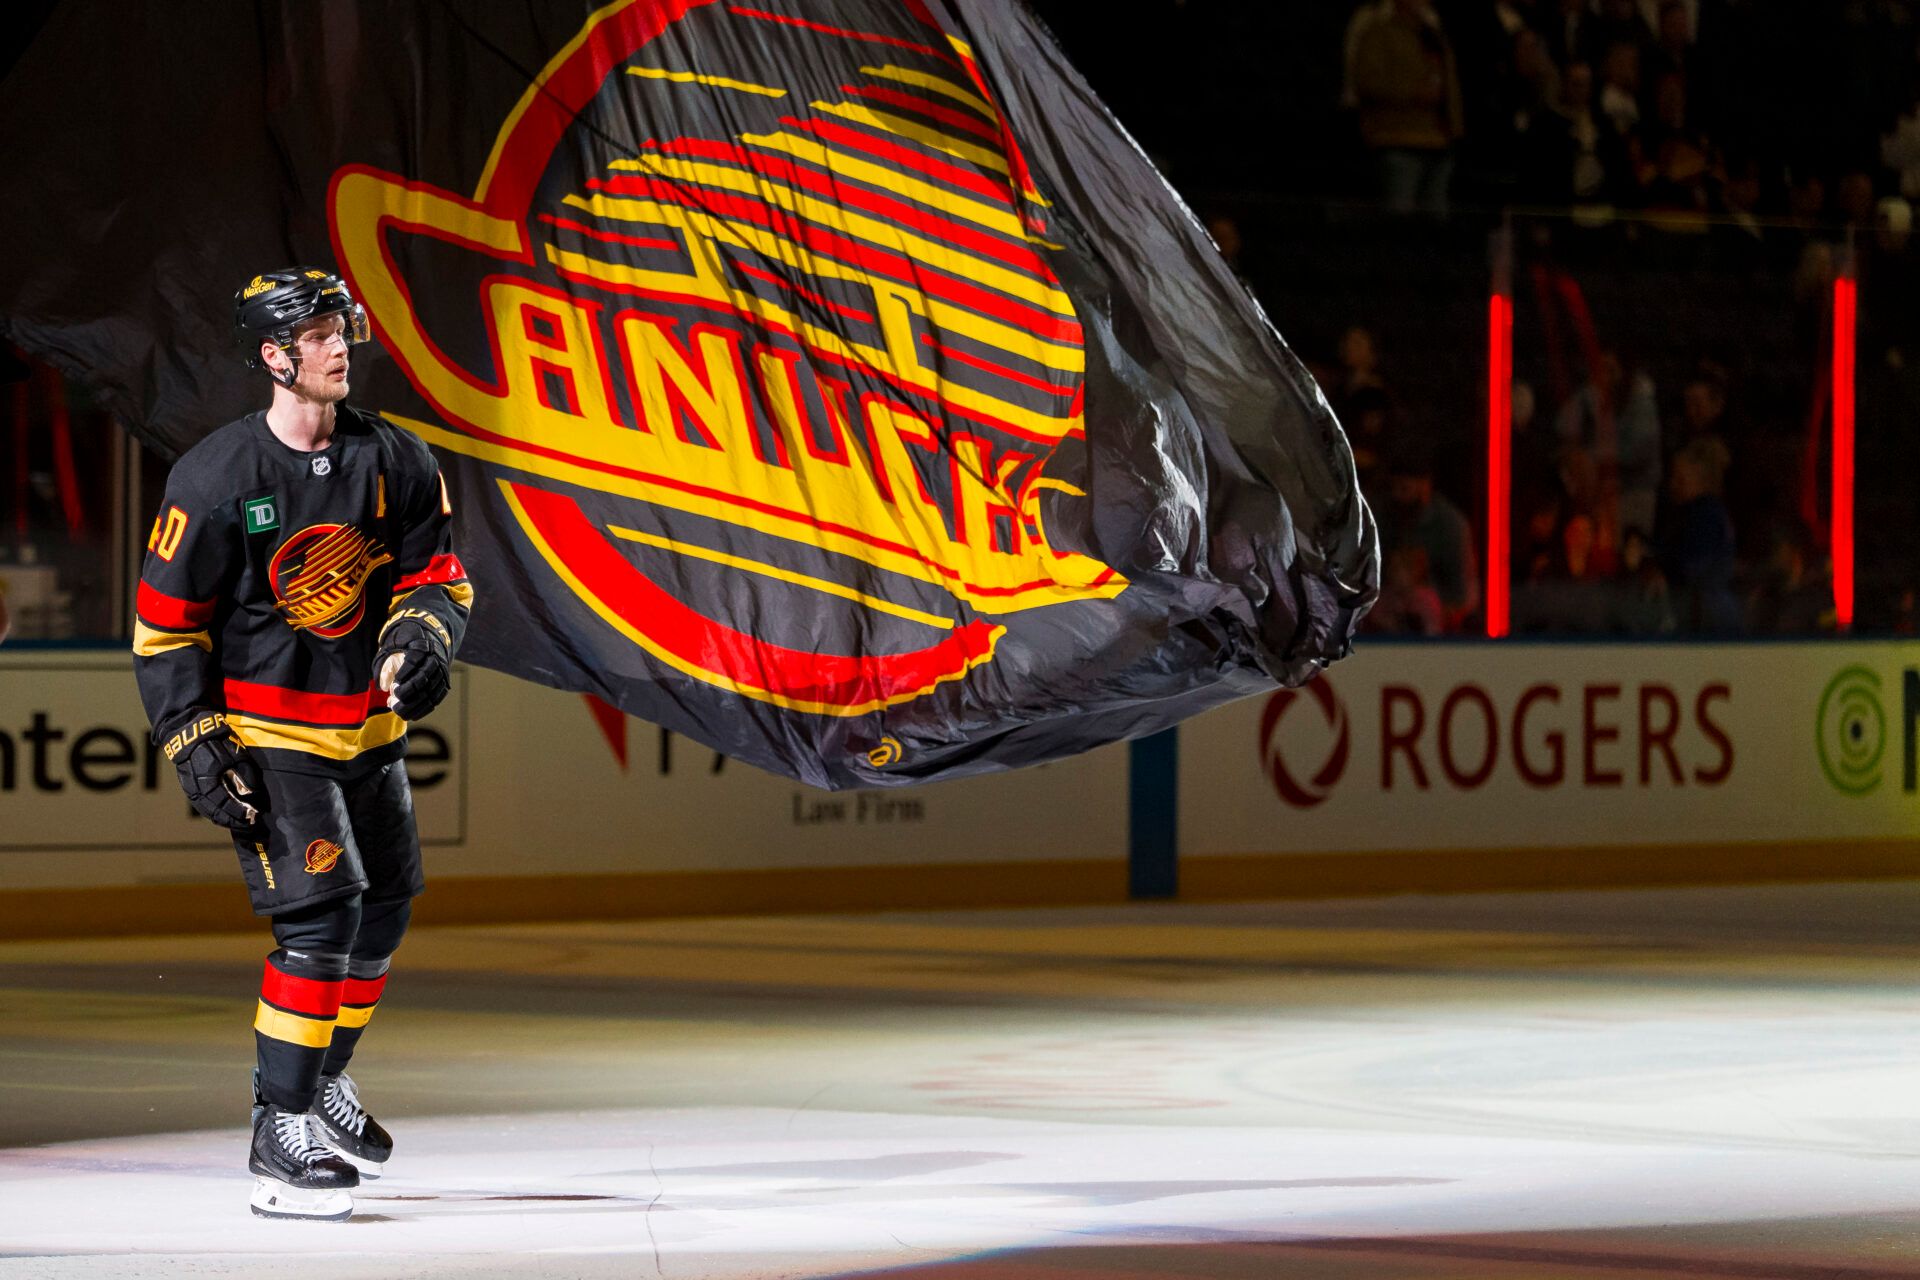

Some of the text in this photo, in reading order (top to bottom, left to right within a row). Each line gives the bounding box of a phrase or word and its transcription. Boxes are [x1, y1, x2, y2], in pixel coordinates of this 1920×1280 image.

[243, 281, 276, 300] NexGen
[326, 164, 1131, 614] CANUCK
[249, 503, 275, 526] TD
[1378, 681, 1736, 791] ROGERS
[255, 842, 276, 890] BAUER
